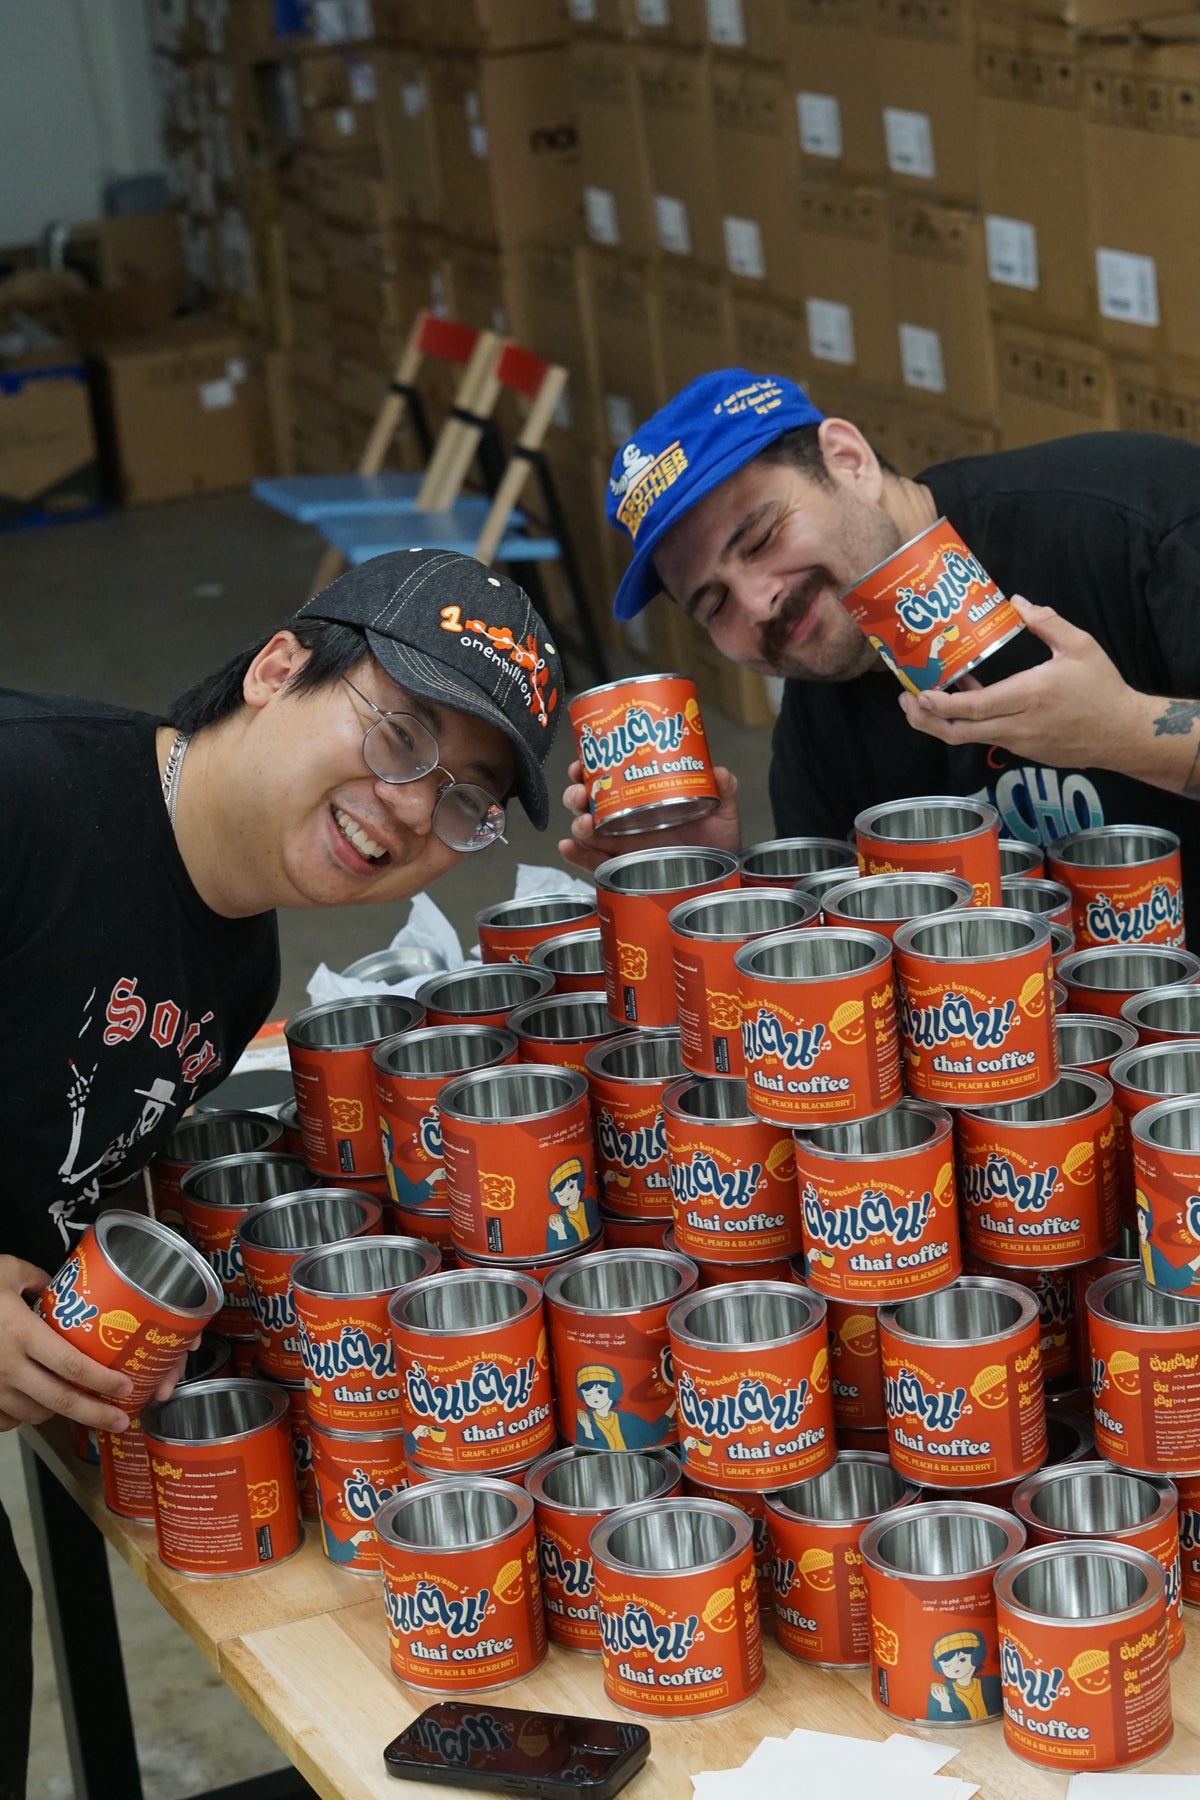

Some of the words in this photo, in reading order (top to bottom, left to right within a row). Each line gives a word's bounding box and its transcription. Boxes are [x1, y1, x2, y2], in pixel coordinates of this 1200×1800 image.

[621, 448, 684, 525] BROTHER
[967, 595, 995, 624] thai
[624, 759, 660, 782] thai
[662, 756, 704, 773] coffee
[625, 783, 648, 796] GRAPE,
[648, 781, 670, 790] PEACH
[964, 766, 1104, 848] CHO
[951, 981, 986, 1002] koysun
[932, 1054, 974, 1074] thai
[975, 1050, 1036, 1074] coffee
[753, 1068, 784, 1092] thai
[786, 1074, 850, 1095] coffee
[932, 1078, 957, 1089] GRAPE,
[958, 1081, 983, 1090] PEACH
[984, 1081, 990, 1089] &
[991, 1072, 1036, 1088] BLACKBERRY
[614, 1104, 656, 1120] provecho!
[772, 1099, 793, 1109] PEACH
[794, 1101, 799, 1109] &
[801, 1100, 850, 1110] BLACKBERRY
[700, 1142, 732, 1163] koysun
[994, 1143, 1028, 1166] koysun
[644, 1171, 672, 1189] tha
[818, 1180, 861, 1198] provecho!
[870, 1179, 905, 1197] koysun
[685, 1211, 721, 1232] thai
[723, 1212, 785, 1233] coffee
[979, 1213, 1015, 1236] thai
[1017, 1216, 1081, 1236] coffee
[687, 1234, 707, 1246] GRAPE,
[707, 1237, 730, 1248] PEACH
[739, 1235, 786, 1247] BLACKBERRY
[1001, 1241, 1024, 1252] PEACH
[1026, 1244, 1031, 1252] &
[1032, 1240, 1081, 1252] BLACKBERRY
[848, 1253, 894, 1272] thai
[896, 1241, 949, 1269] coffee
[848, 1278, 876, 1288] GRAPE,
[877, 1276, 902, 1287] PEACH
[904, 1276, 910, 1284] &
[911, 1263, 950, 1282] BLACKBERRY
[306, 1319, 341, 1332] provecho!
[349, 1317, 383, 1334] koysun
[427, 1357, 471, 1373] provecho!
[480, 1352, 513, 1365] koysun
[905, 1359, 935, 1384] koysun
[695, 1371, 739, 1386] provecho!
[748, 1369, 783, 1385] koysun
[333, 1385, 373, 1403] thai
[333, 1409, 358, 1418] GRAPE,
[359, 1409, 382, 1417] PEACH
[461, 1421, 505, 1443] thai
[507, 1403, 550, 1435] coffee
[461, 1449, 490, 1459] GRAPE,
[491, 1444, 515, 1456] PEACH
[515, 1441, 521, 1449] &
[521, 1423, 551, 1447] BLACKBERRY
[726, 1441, 771, 1461] thai
[774, 1427, 826, 1458] coffee
[894, 1427, 924, 1452] thai
[927, 1437, 991, 1457] coffee
[726, 1466, 755, 1476] GRAPE,
[755, 1465, 781, 1476] PEACH
[782, 1464, 788, 1472] &
[789, 1448, 826, 1469] BLACKBERRY
[911, 1458, 932, 1469] PEACH
[934, 1462, 940, 1470] &
[941, 1462, 991, 1472] BLACKBERRY
[424, 1571, 459, 1592] koysun
[632, 1593, 667, 1616] koysun
[775, 1602, 818, 1632] coffee
[409, 1640, 449, 1661] thai
[451, 1637, 514, 1662] coffee
[410, 1663, 433, 1675] GRAPE,
[434, 1666, 458, 1677] PEACH
[460, 1668, 466, 1676] &
[467, 1657, 515, 1676] BLACKBERRY
[617, 1663, 656, 1686] thai
[658, 1665, 723, 1687] coffee
[618, 1685, 640, 1699] GRAPE,
[641, 1690, 665, 1701] PEACH
[667, 1693, 673, 1702] &
[674, 1687, 724, 1702] BLACKBERRY
[1003, 1697, 1024, 1726] thai
[1026, 1718, 1090, 1740] coffee
[1039, 1743, 1091, 1756] BLACKBERRY
